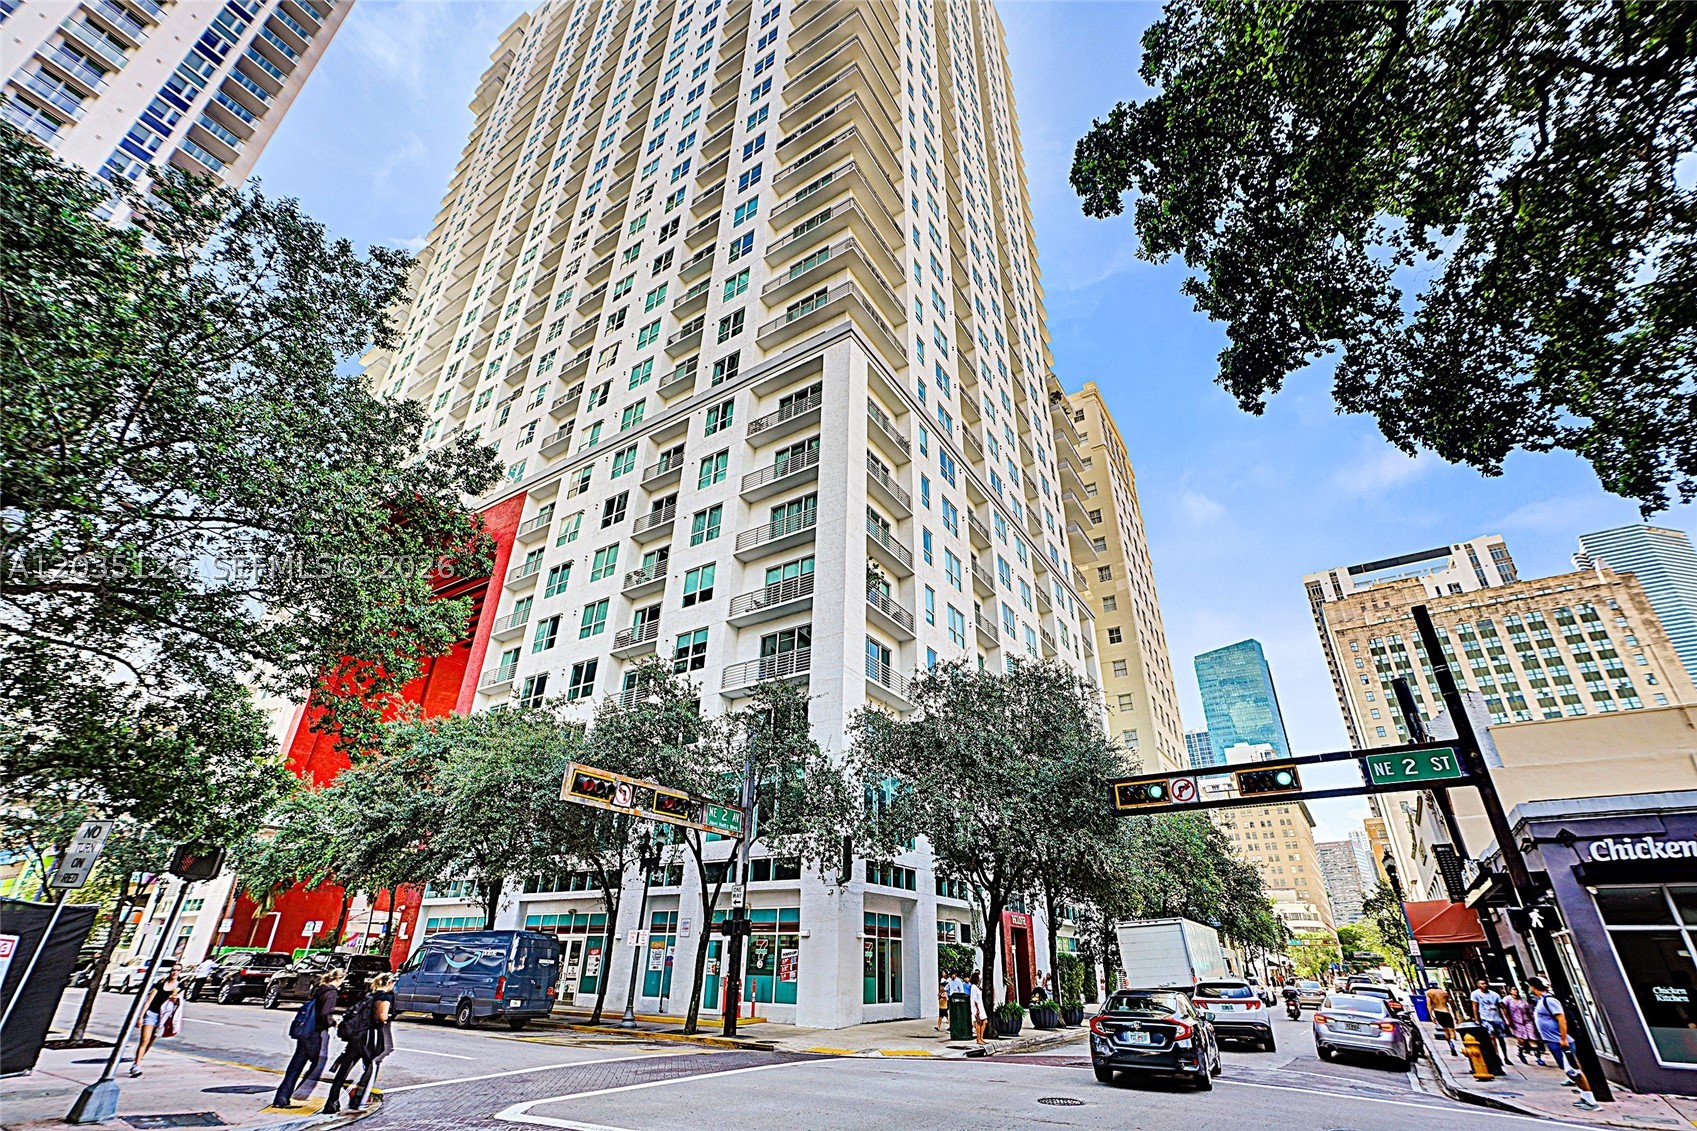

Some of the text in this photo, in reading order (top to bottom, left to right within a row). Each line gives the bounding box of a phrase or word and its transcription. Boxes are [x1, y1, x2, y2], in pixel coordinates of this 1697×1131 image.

[1373, 756, 1451, 776] NE 2 ST
[709, 806, 717, 818] NE
[721, 809, 728, 822] 2
[83, 825, 103, 839] NO
[1589, 836, 1697, 862] Chicken
[71, 858, 86, 868] ON
[61, 873, 79, 884] RED
[732, 885, 743, 893] ONE
[1652, 986, 1688, 995] Chicken
[1655, 993, 1691, 1003] Kitchen
